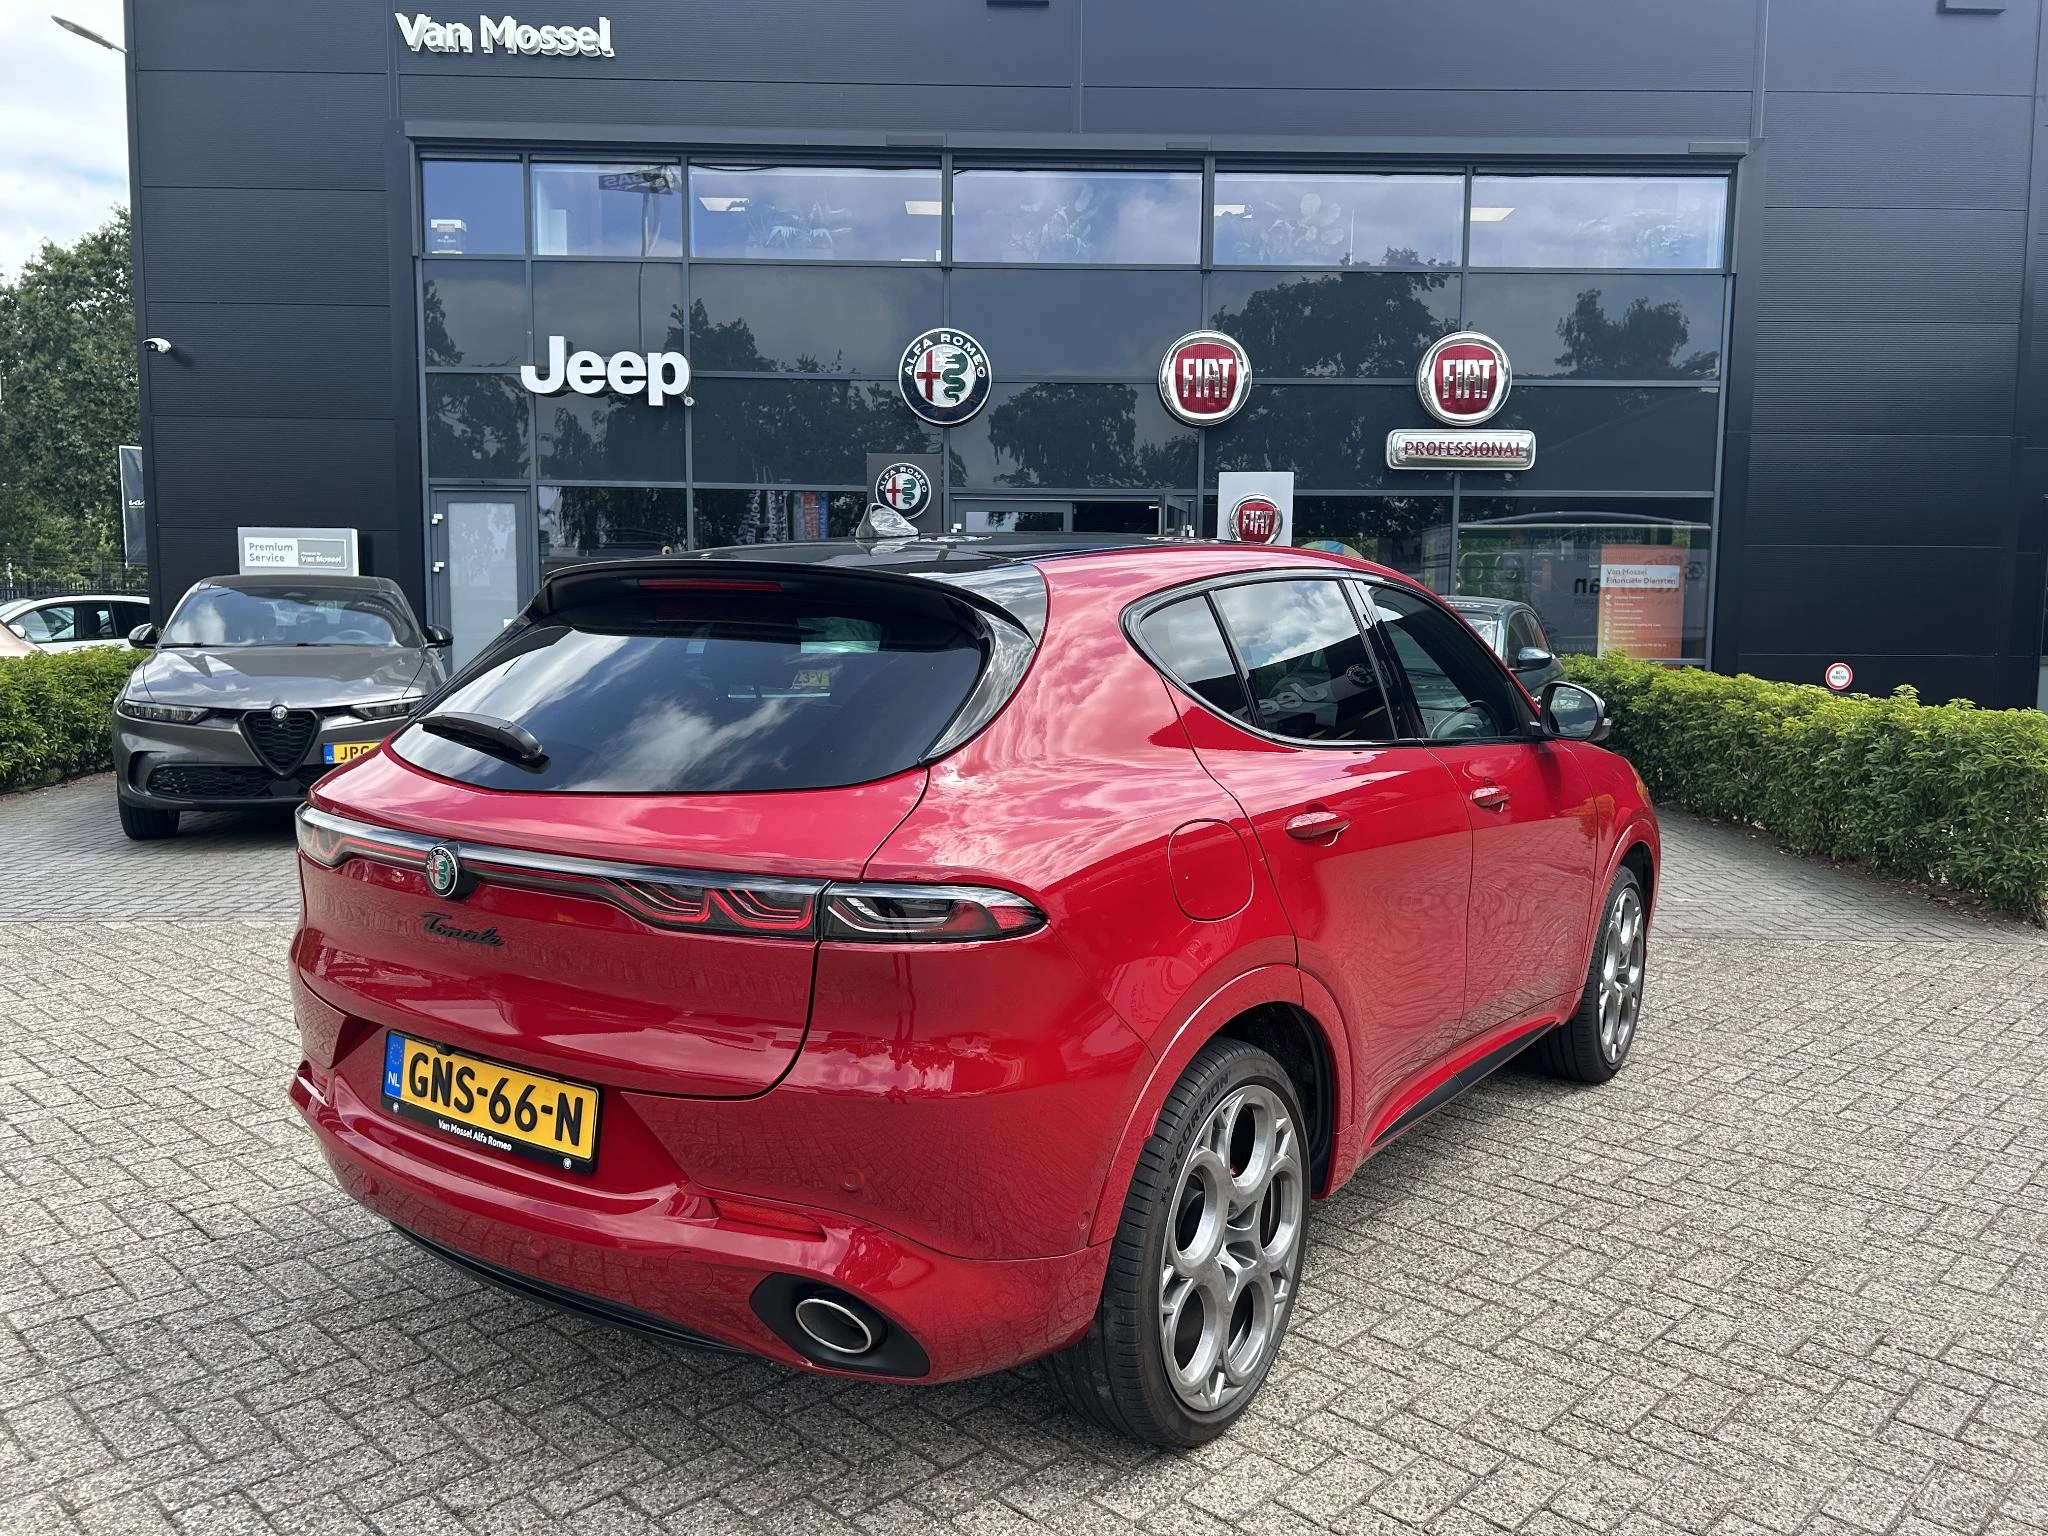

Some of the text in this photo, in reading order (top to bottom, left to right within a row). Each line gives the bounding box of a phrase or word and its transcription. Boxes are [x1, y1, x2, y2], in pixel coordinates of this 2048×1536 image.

[395, 12, 615, 58] Van Mossel
[520, 335, 691, 406] Jeep
[904, 333, 986, 378] ALFA ROMEO
[1182, 358, 1234, 398] FIAT
[1442, 359, 1495, 399] FIAT
[1404, 441, 1523, 457] PROFESSIONAL
[880, 466, 928, 493] ALFA ROMEO
[1242, 510, 1274, 535] FIAT
[249, 542, 293, 552] Premium
[249, 553, 285, 562] Service
[1606, 568, 1621, 576] Van
[387, 1070, 400, 1088] NL
[409, 1052, 584, 1147] GNS-66-N
[438, 1119, 512, 1152] Van Mossel Alfa Romeo
[1168, 1073, 1231, 1180] SCORPION
